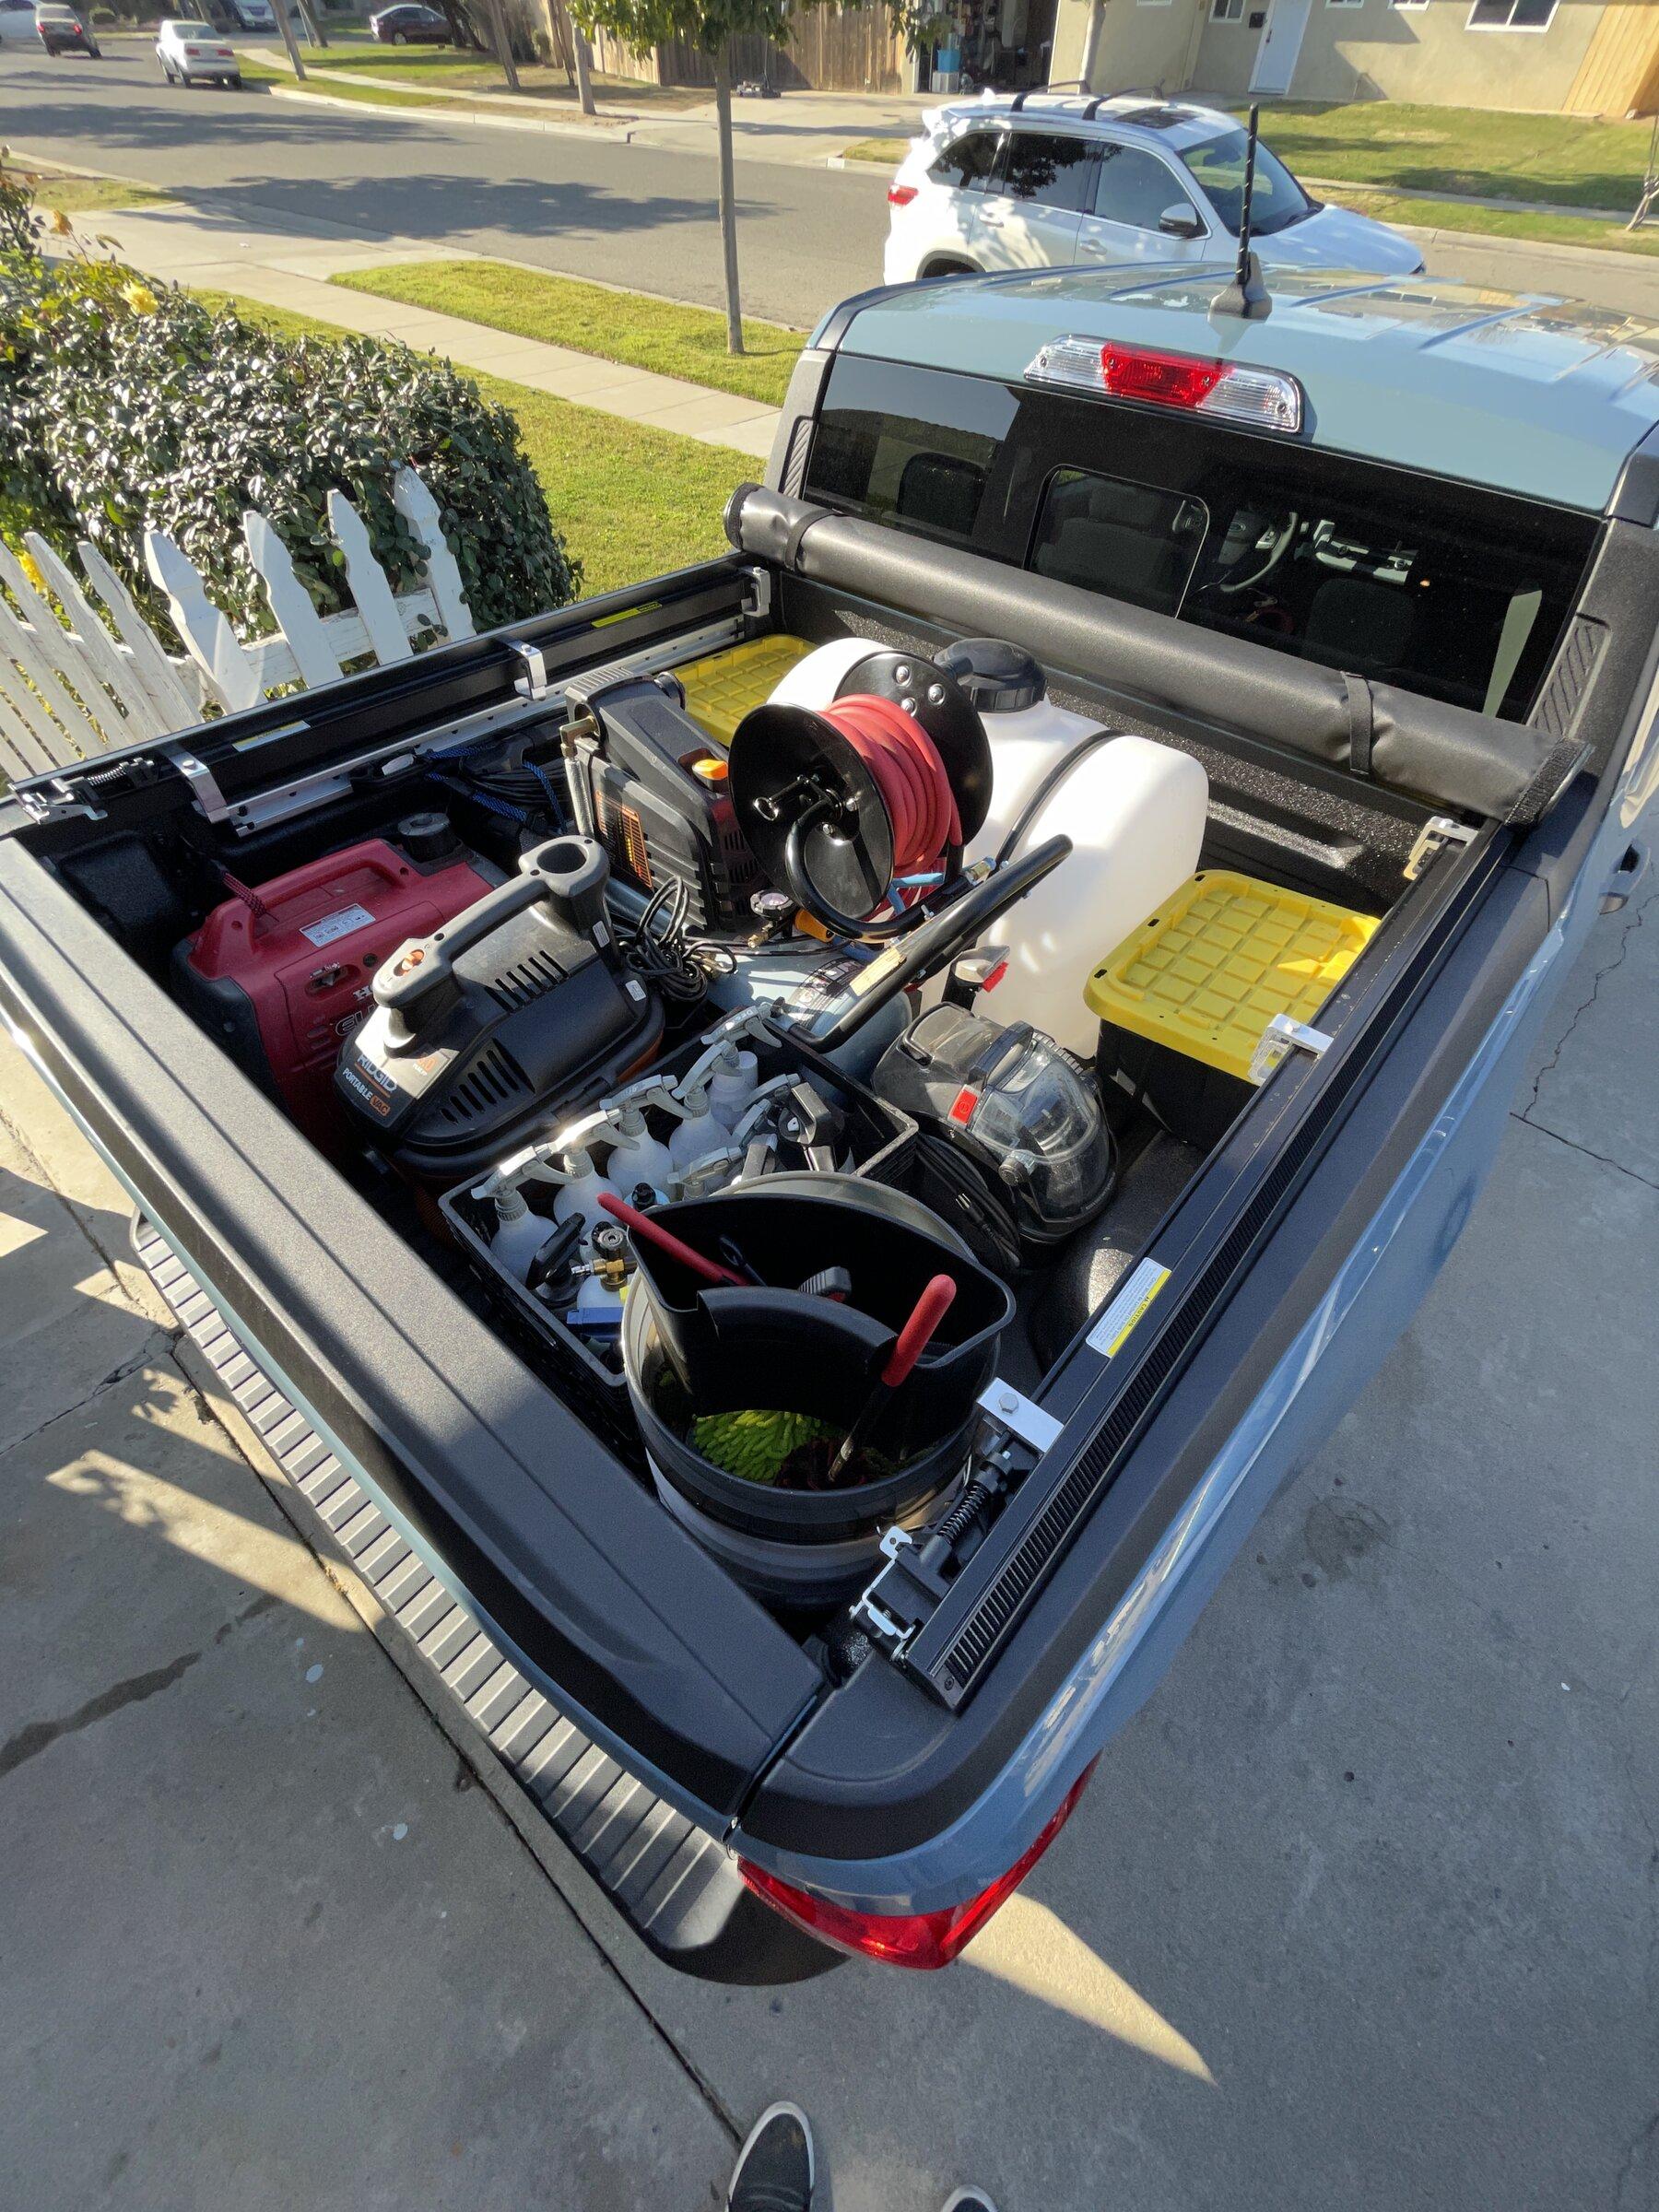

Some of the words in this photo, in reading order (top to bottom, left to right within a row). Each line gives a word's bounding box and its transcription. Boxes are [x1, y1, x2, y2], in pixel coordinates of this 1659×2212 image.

[342, 1067, 374, 1100] PORTABLE
[371, 1097, 390, 1116] VAC
[357, 1053, 398, 1092] RIDGID
[1128, 1302, 1147, 1328] CAUTION
